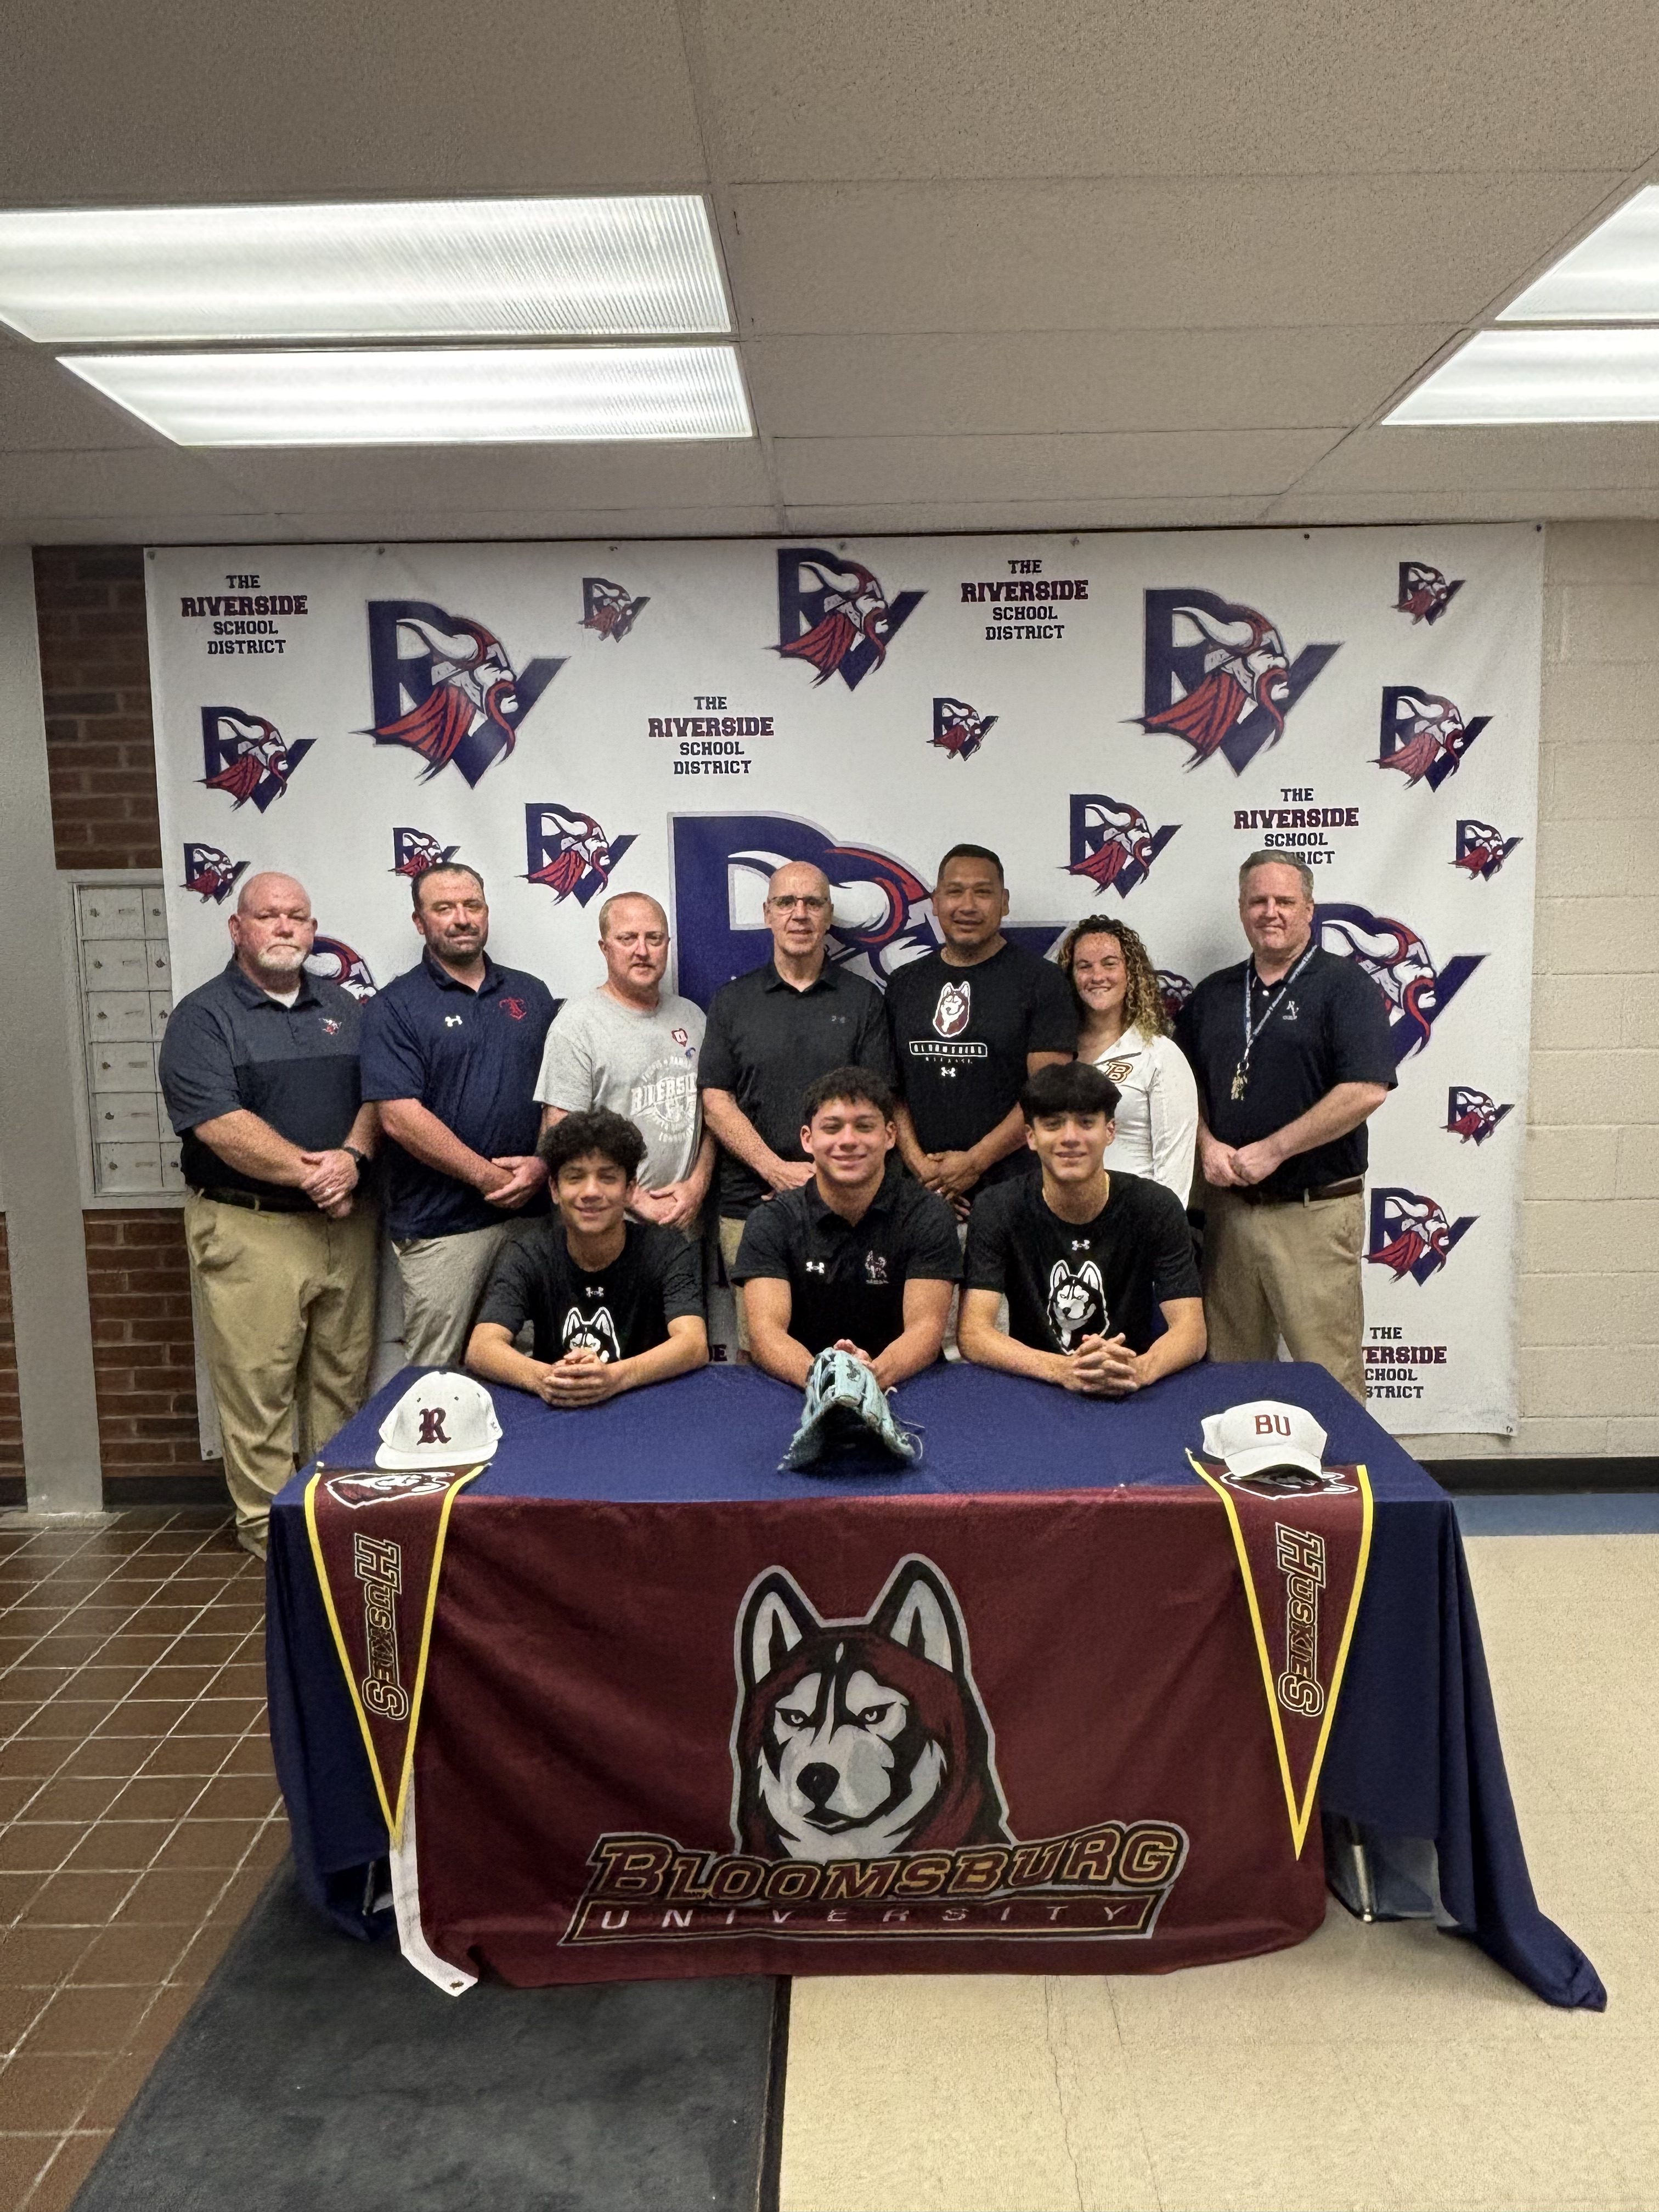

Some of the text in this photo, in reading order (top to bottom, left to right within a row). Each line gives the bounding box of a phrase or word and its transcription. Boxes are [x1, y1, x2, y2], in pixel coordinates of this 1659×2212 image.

[1008, 560, 1042, 574] THE
[225, 575, 261, 589] THE
[961, 580, 1088, 602] RIVERSIDE
[181, 595, 308, 617] RIVERSIDE
[992, 606, 1058, 620] SCHOOL
[213, 620, 279, 635] SCHOOL
[985, 625, 1064, 640] DISTRICT
[207, 640, 286, 654] DISTRICT
[694, 697, 727, 710] THE
[648, 716, 774, 737] RIVERSIDE
[680, 741, 744, 755] SCHOOL
[674, 760, 752, 775] DISTRICT
[1280, 788, 1313, 802] THE
[1234, 807, 1359, 830] RIVERSIDE
[1265, 832, 1328, 847] SCHOOL
[1296, 851, 1335, 865] RICT
[1369, 1327, 1402, 1339] THE
[1362, 1346, 1447, 1364] ERSIDE
[1365, 1368, 1418, 1381] CHOOL
[1365, 1385, 1424, 1398] STRICT
[416, 1407, 452, 1446] R
[1254, 1414, 1291, 1437] BU
[354, 1532, 408, 1720] HUSKIES
[1276, 1522, 1326, 1717] HUSKIES
[595, 1827, 1182, 1901] BLOOMSBURG
[601, 1905, 1126, 1929] UNIVERSITY
